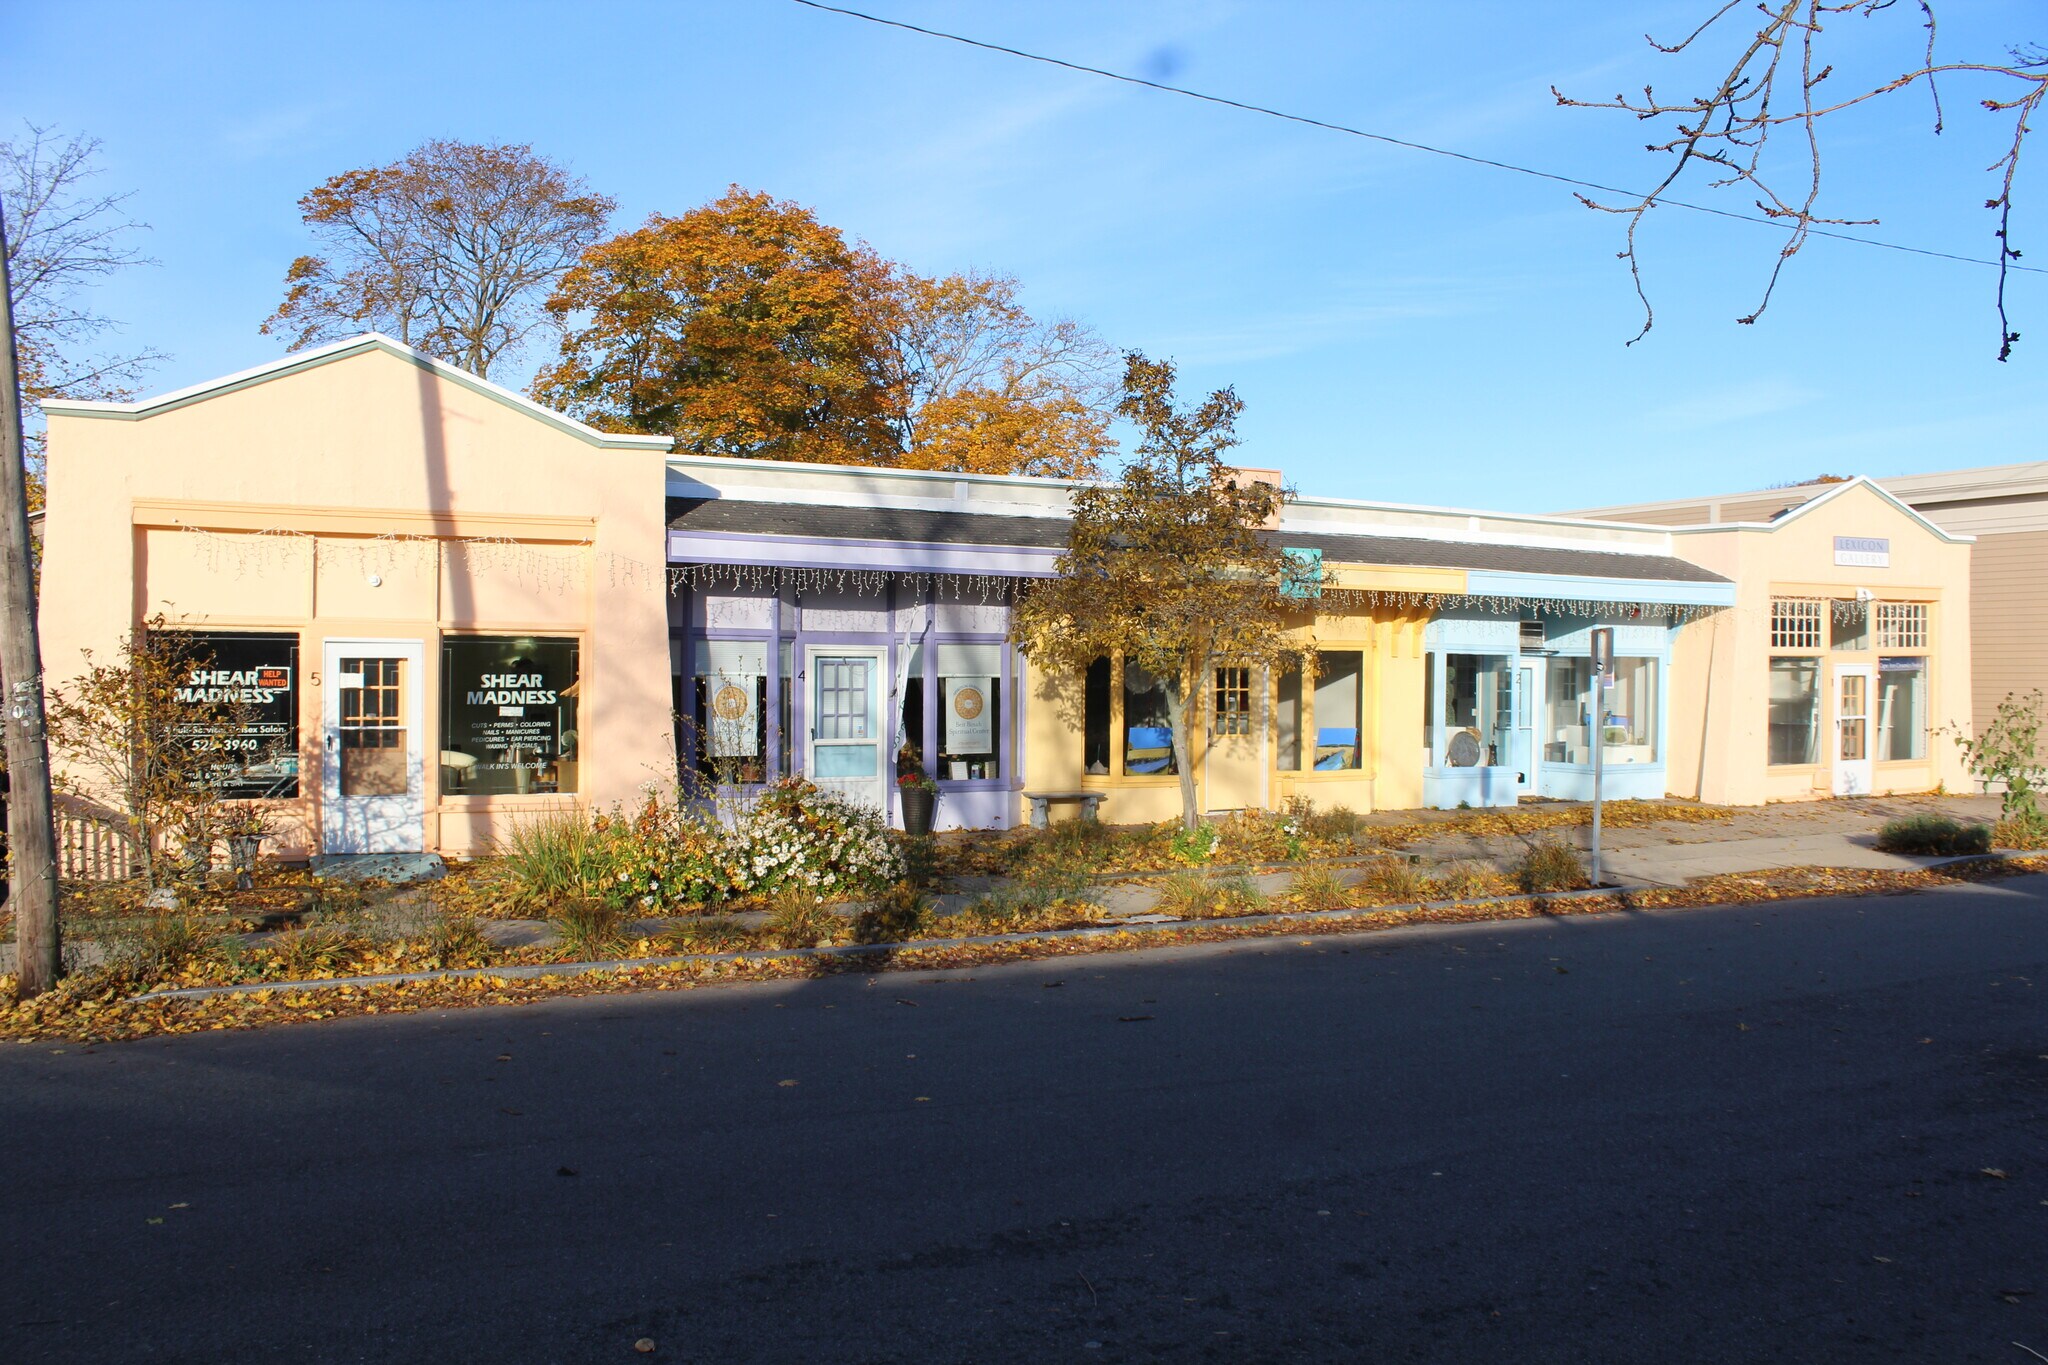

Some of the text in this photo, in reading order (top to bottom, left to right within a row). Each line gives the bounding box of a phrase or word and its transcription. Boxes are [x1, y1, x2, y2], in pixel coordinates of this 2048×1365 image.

[1840, 538, 1883, 550] LEXICON
[1840, 553, 1883, 564] GALLERY
[189, 670, 258, 686] SHEAR
[263, 670, 281, 678] HELP
[310, 672, 322, 686] 5
[797, 670, 806, 682] 4
[1515, 673, 1521, 684] 2
[258, 679, 286, 687] WANTED
[480, 674, 542, 688] SHEAR
[173, 688, 274, 704] MADNESS
[466, 690, 556, 704] MADNESS
[191, 740, 258, 750] 523960
[510, 762, 547, 770] WELCOME
